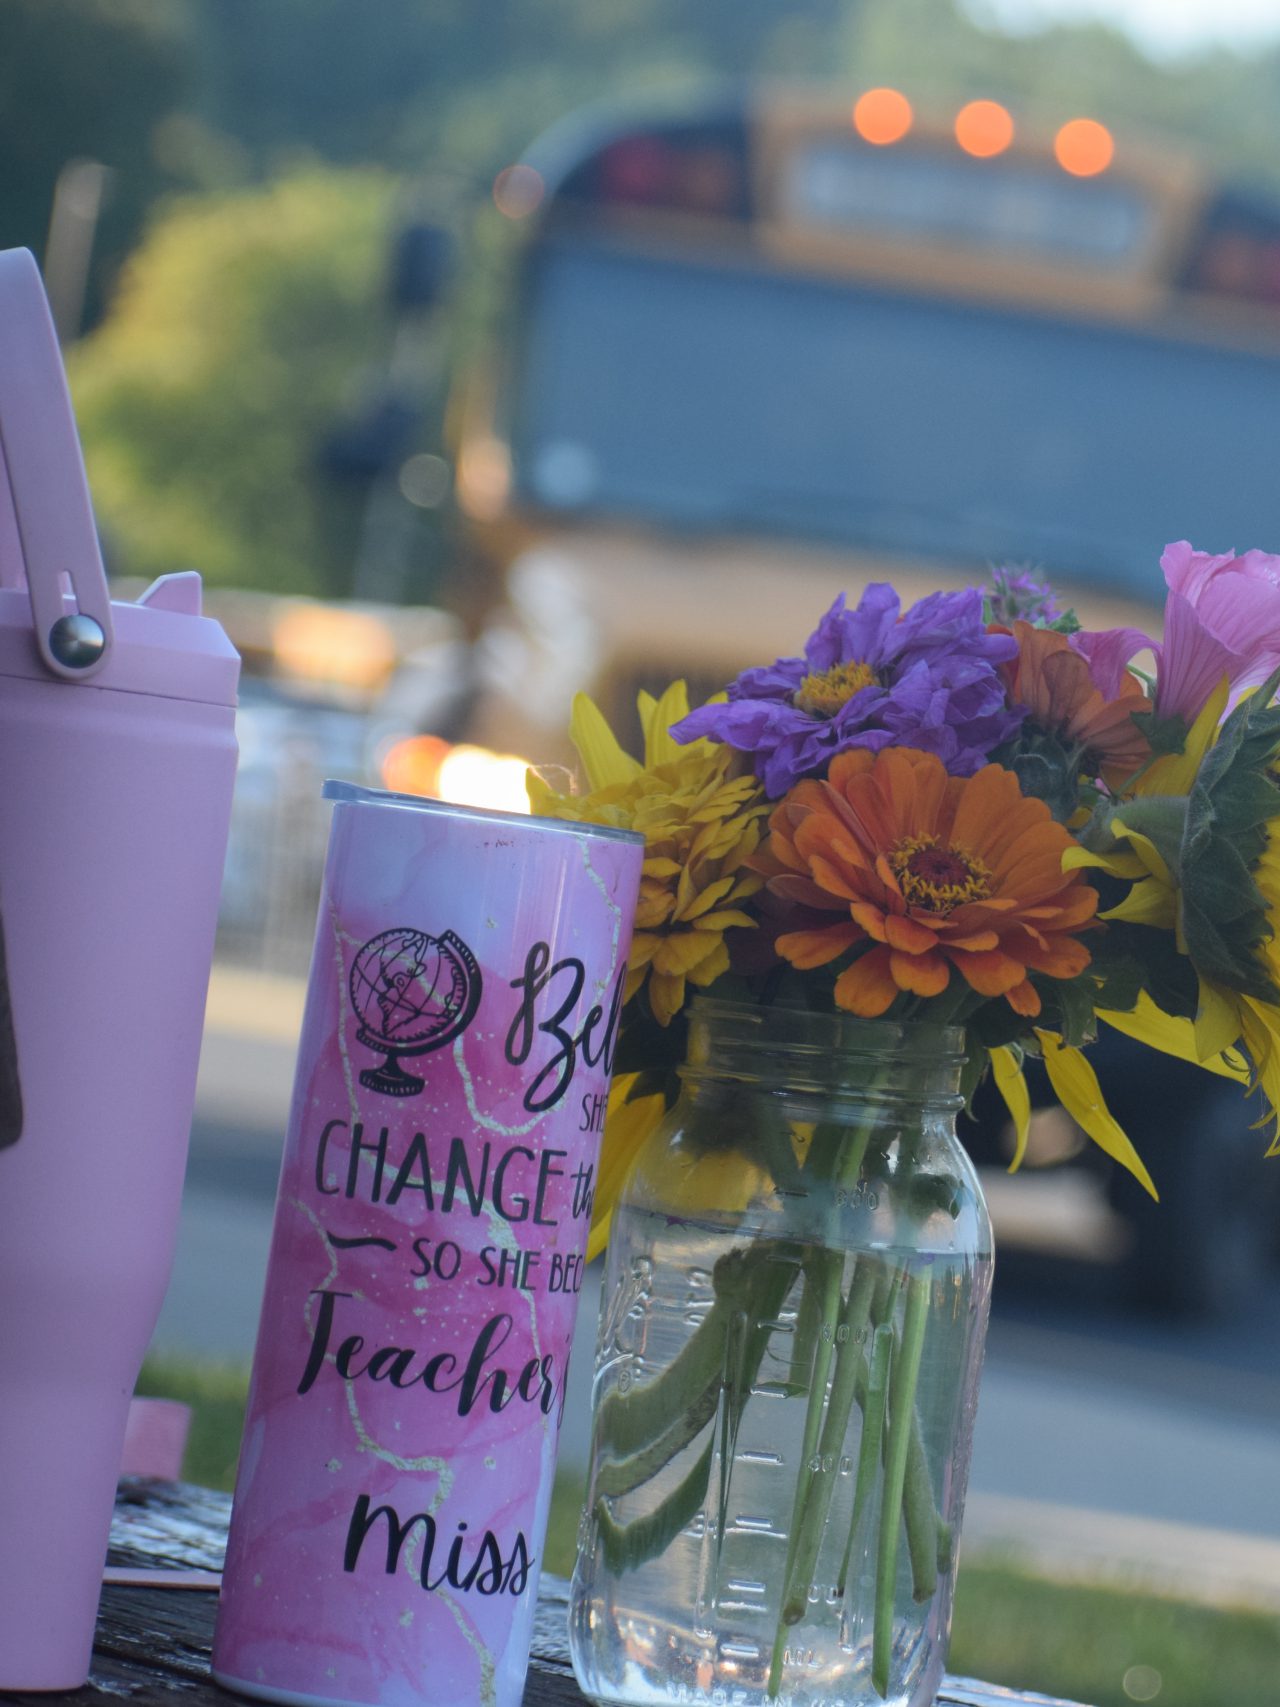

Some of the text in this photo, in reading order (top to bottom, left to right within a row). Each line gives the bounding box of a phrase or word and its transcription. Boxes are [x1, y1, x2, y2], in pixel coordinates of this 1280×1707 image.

[315, 1119, 568, 1226] CHANGE
[410, 1237, 460, 1281] SO
[476, 1246, 540, 1290] SHE
